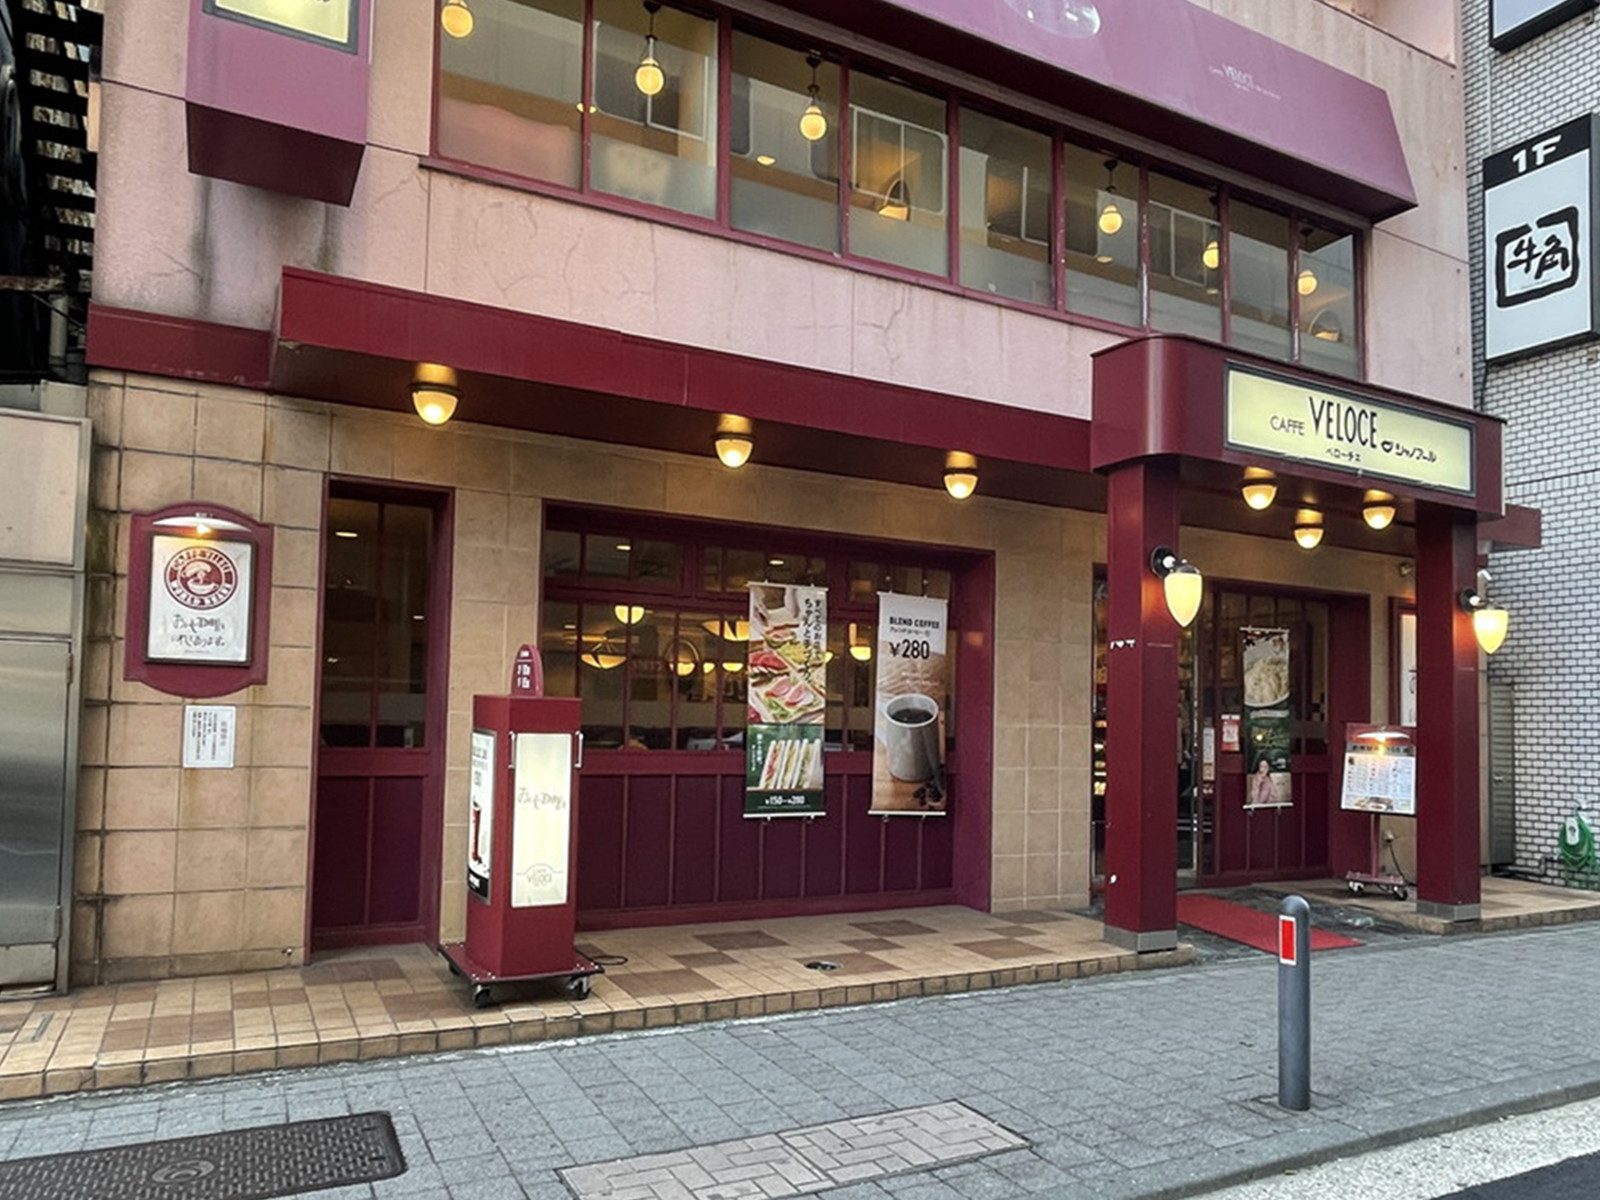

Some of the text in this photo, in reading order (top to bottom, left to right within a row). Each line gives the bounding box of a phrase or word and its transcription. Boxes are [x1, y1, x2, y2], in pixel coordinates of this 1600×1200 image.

[1512, 134, 1562, 173] 1F
[1506, 234, 1570, 280] 牛角
[1270, 415, 1305, 436] CAFFE
[1308, 396, 1378, 449] VELOCE
[889, 616, 940, 629] BLEND COFFEE
[888, 638, 930, 660] ¥280
